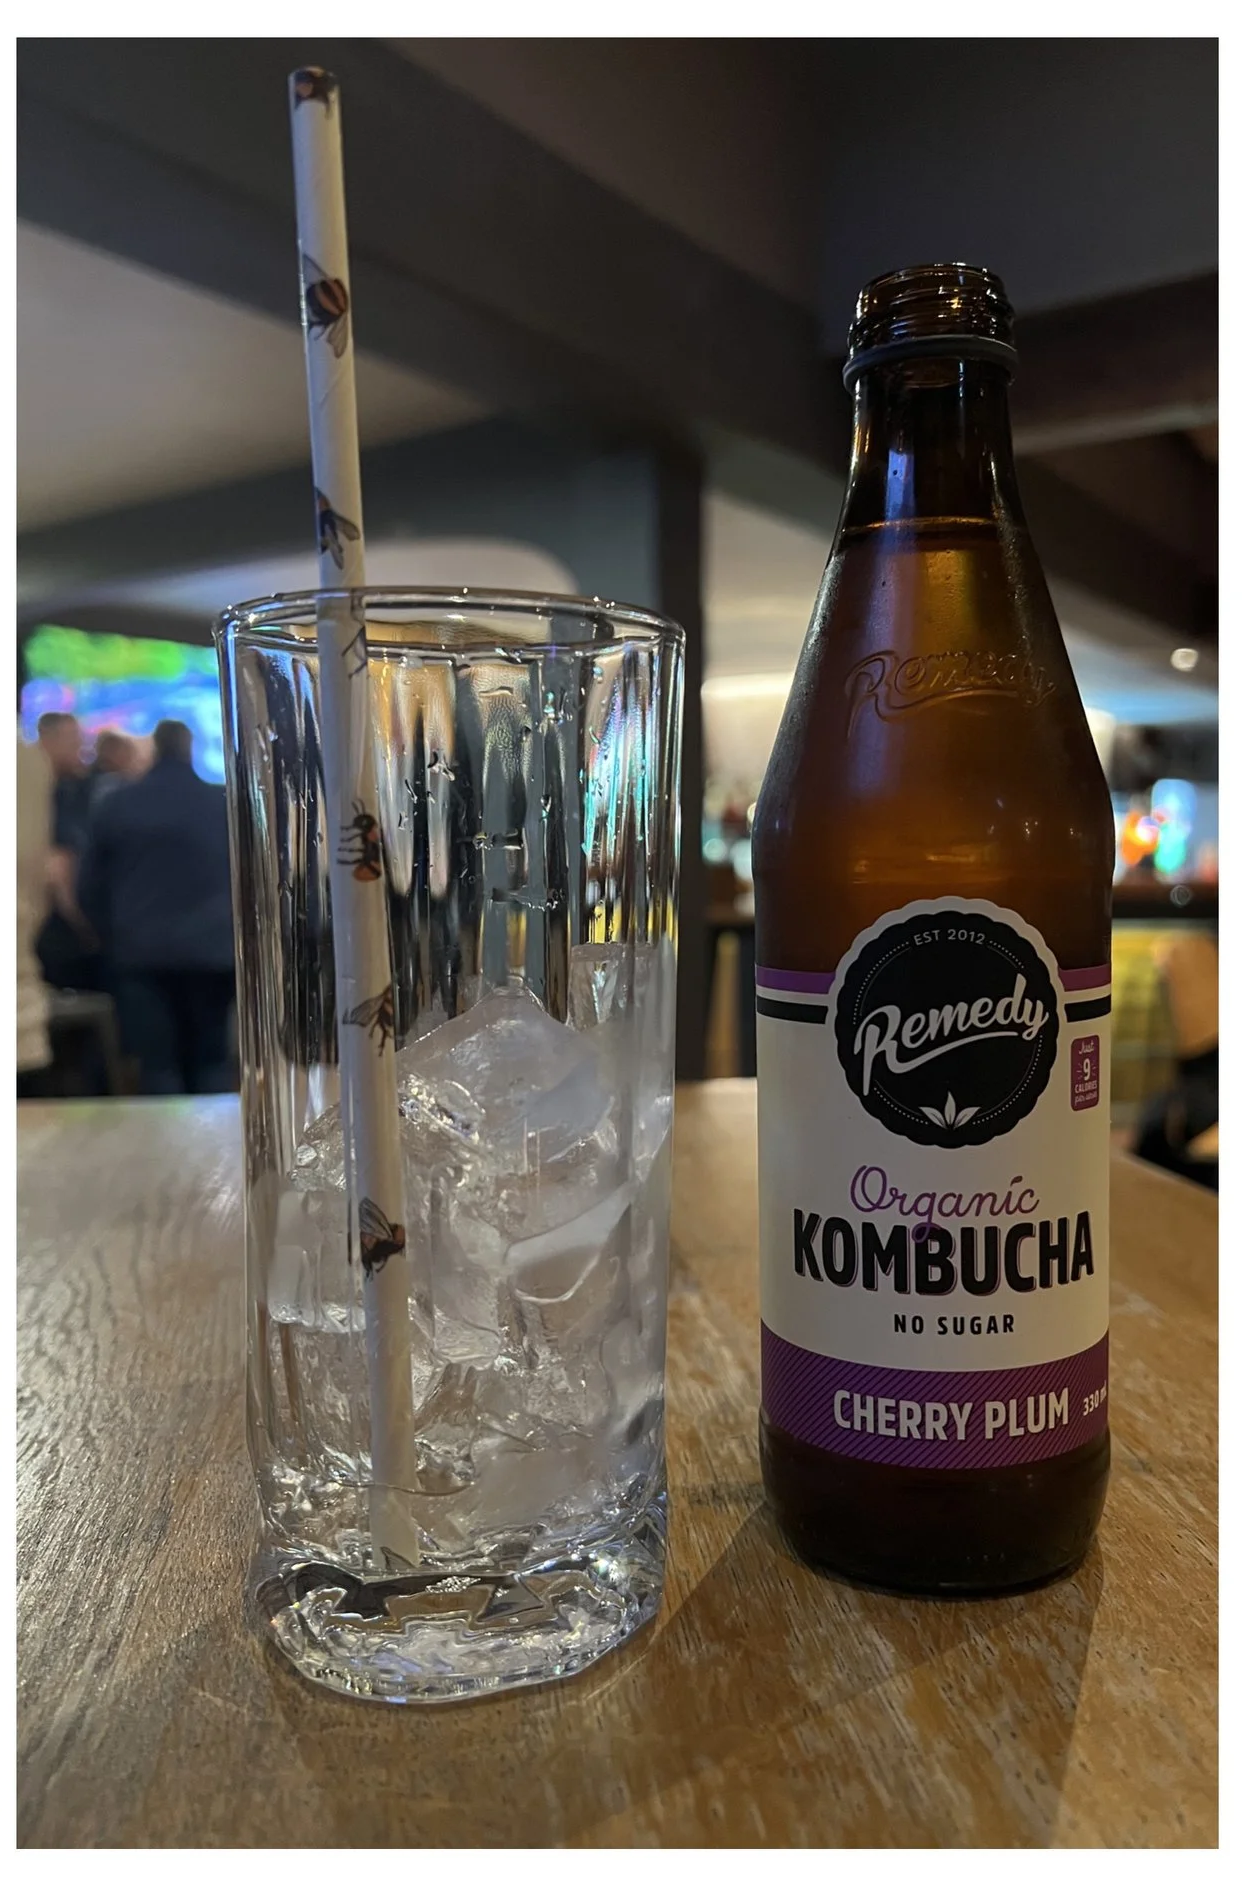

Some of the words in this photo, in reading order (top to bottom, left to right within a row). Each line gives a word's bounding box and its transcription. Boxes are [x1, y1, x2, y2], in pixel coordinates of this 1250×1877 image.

[913, 928, 941, 946] EST
[947, 928, 986, 945] 2012
[853, 973, 1050, 1096] Remedy
[1082, 1058, 1091, 1081] 9
[850, 1164, 1040, 1244] Organic
[793, 1208, 1095, 1296] KOMBUCHA
[894, 1314, 925, 1335] NO
[937, 1313, 1016, 1336] SUGAR
[833, 1388, 973, 1441] CHERRY
[984, 1386, 1070, 1440] PLUM
[1082, 1389, 1100, 1417] 330
